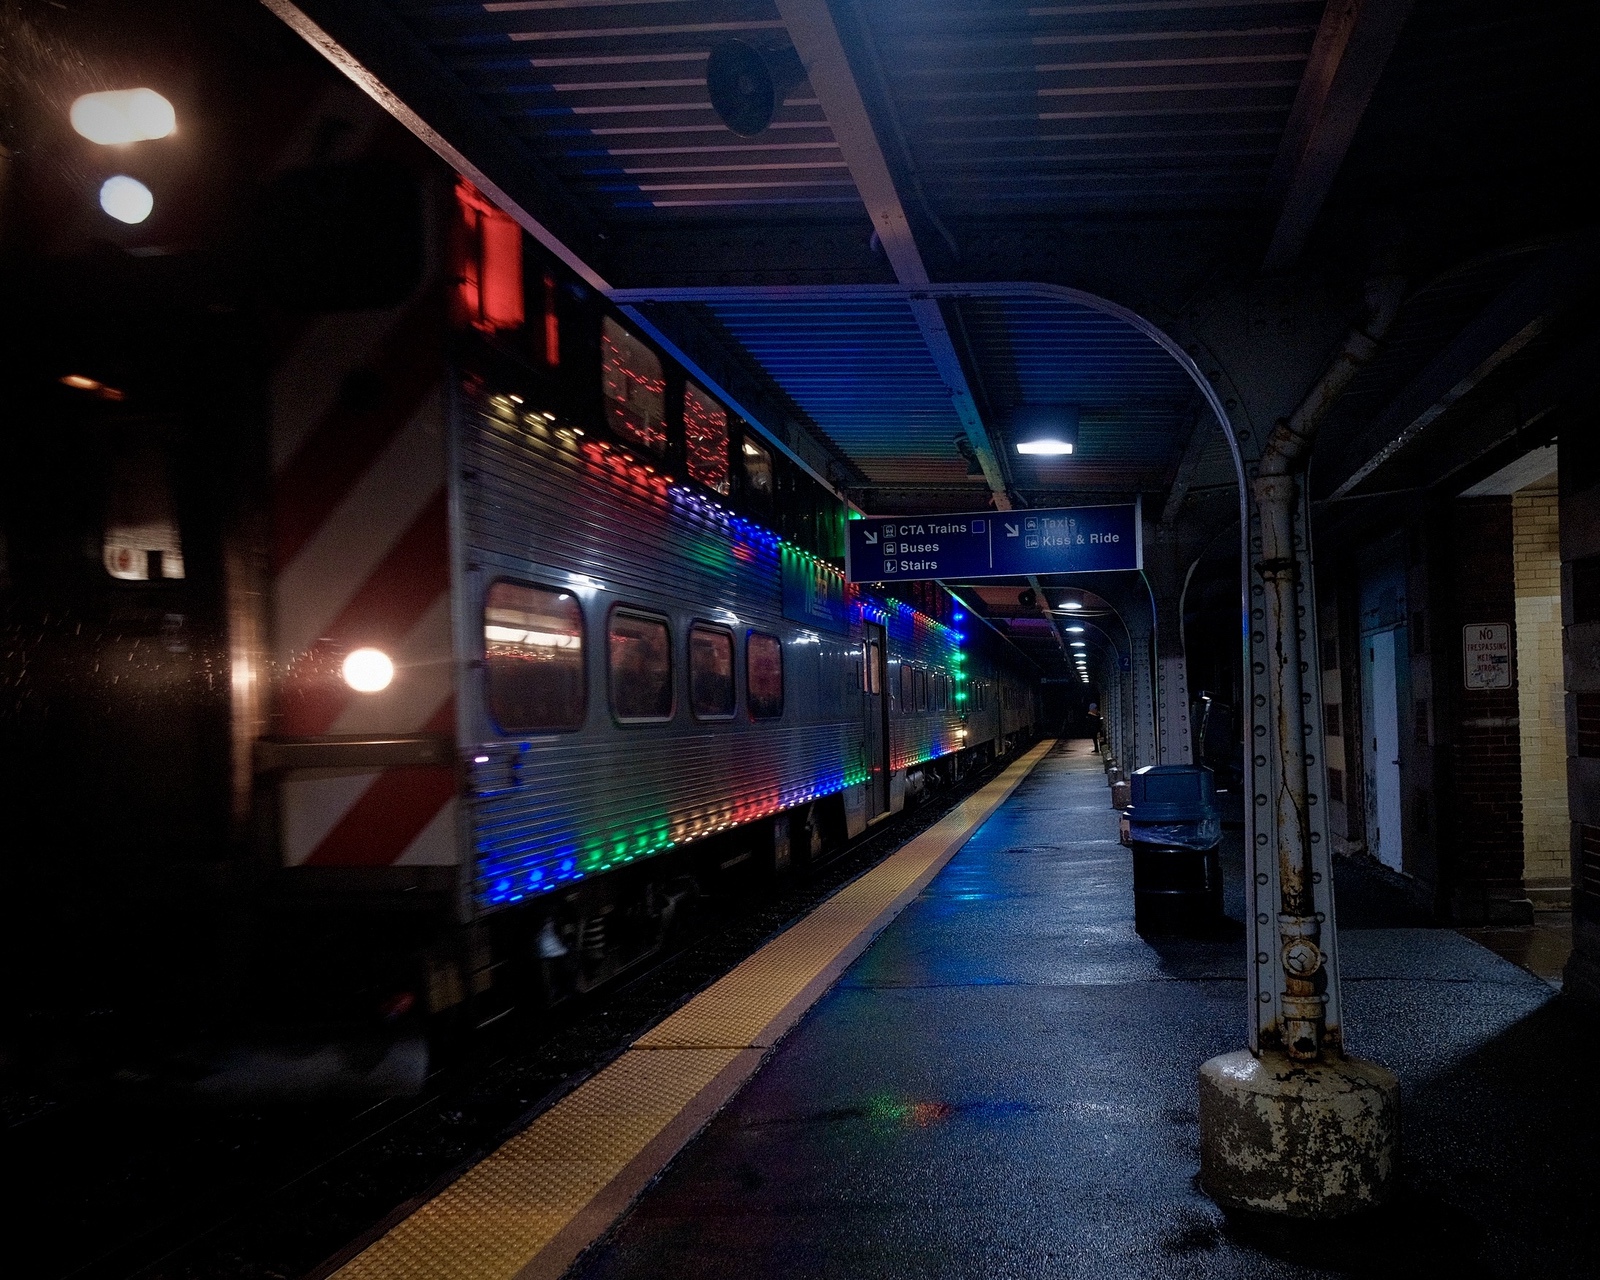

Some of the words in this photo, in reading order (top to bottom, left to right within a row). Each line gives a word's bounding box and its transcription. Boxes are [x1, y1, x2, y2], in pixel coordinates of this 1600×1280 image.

[899, 524, 926, 536] CTA
[927, 522, 967, 535] Trains
[1041, 517, 1076, 529] Taxis
[1042, 535, 1071, 547] Kiss
[1076, 534, 1085, 545] &
[1089, 532, 1120, 544] Ride
[900, 542, 940, 554] Buses
[900, 559, 938, 571] Stairs
[1479, 629, 1493, 640] NO
[1467, 643, 1506, 651] TRESPASSING
[1123, 658, 1129, 666] 2
